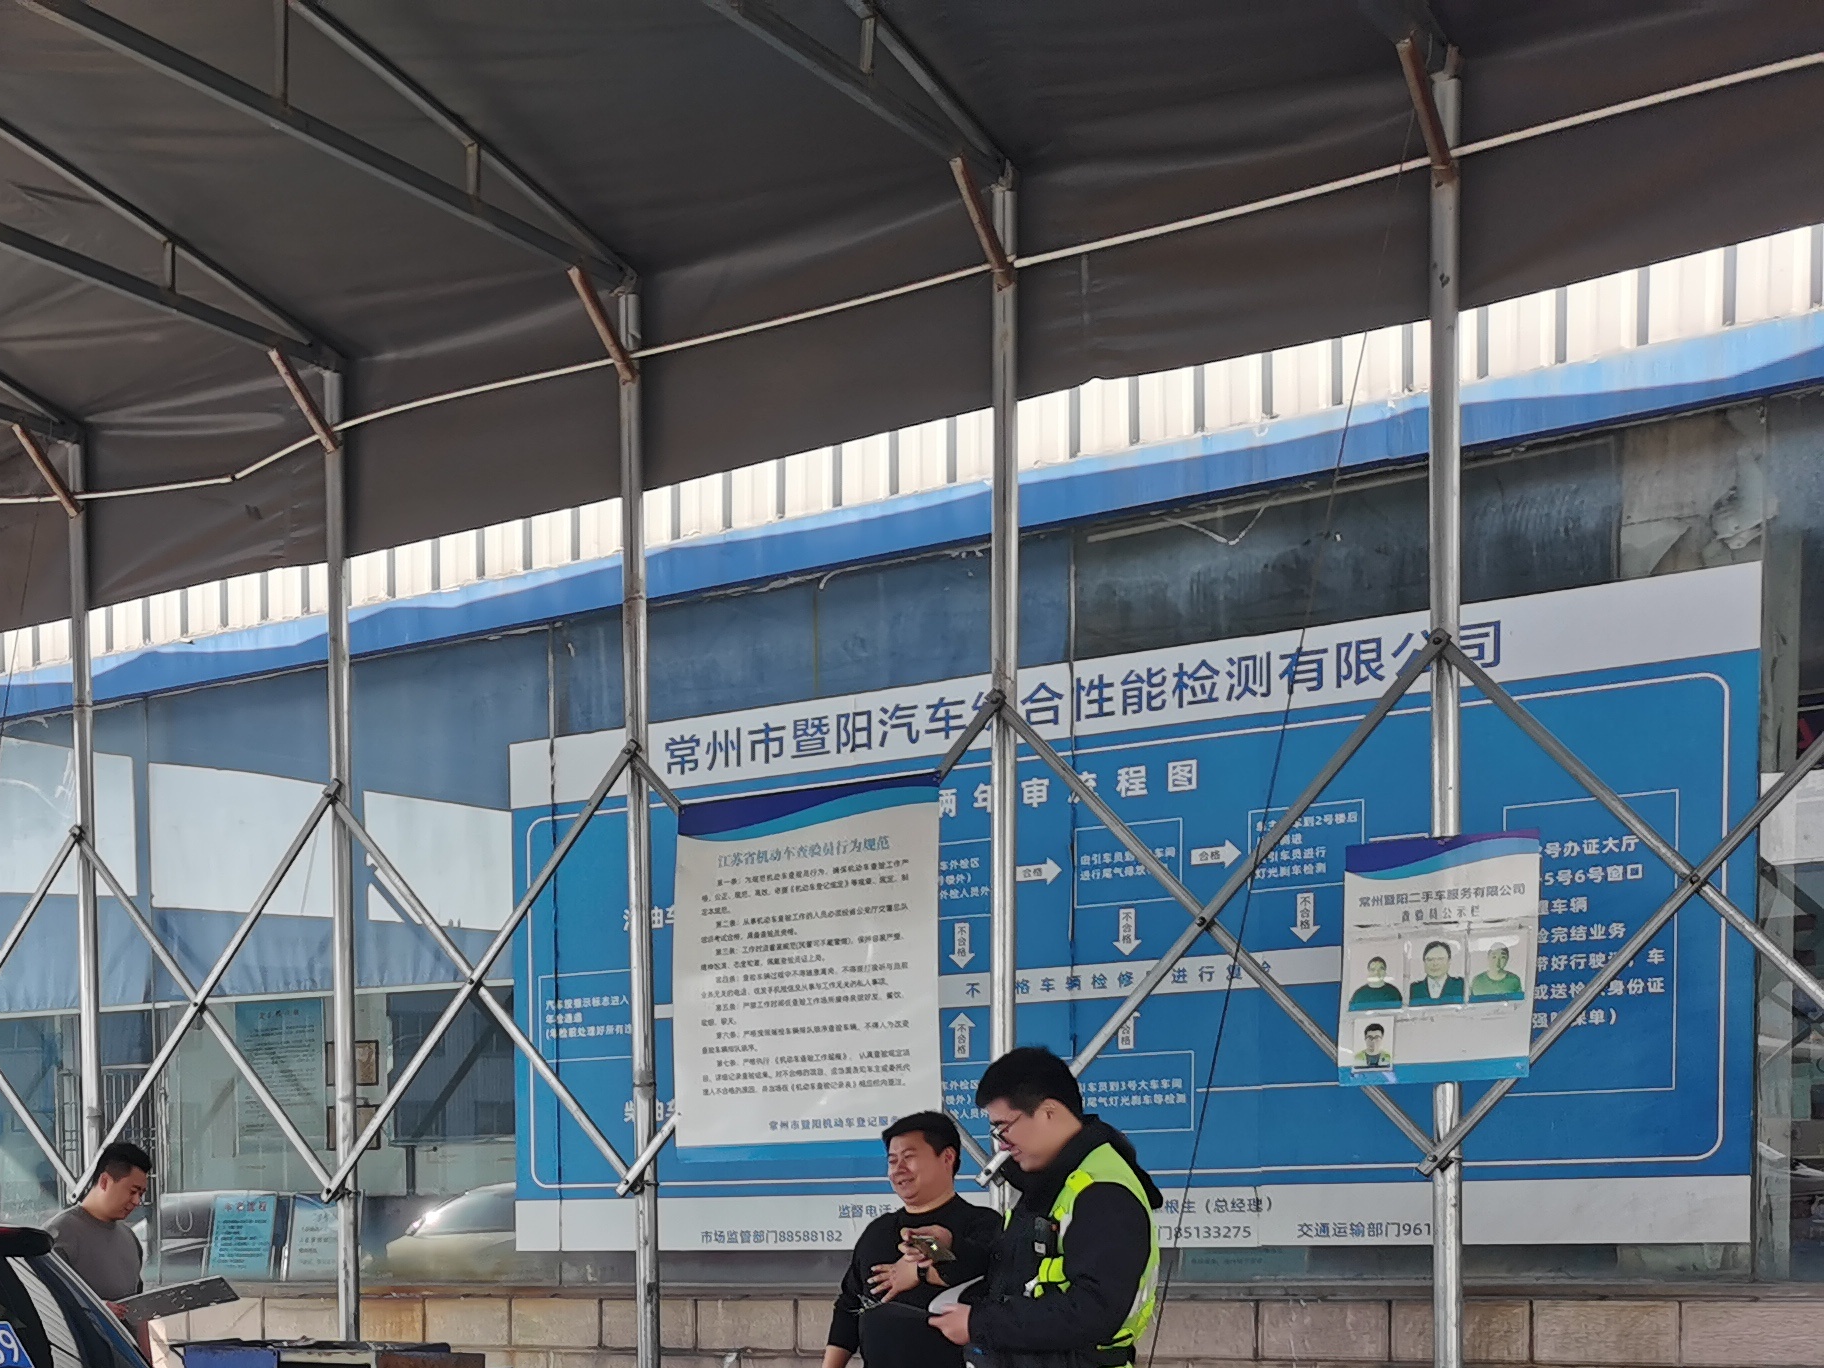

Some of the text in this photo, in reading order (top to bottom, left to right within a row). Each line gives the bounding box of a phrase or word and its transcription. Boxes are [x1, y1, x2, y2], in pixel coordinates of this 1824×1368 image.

[1198, 851, 1221, 862] 合格
[1121, 911, 1132, 944] 不合格
[1299, 896, 1311, 930] 不合格
